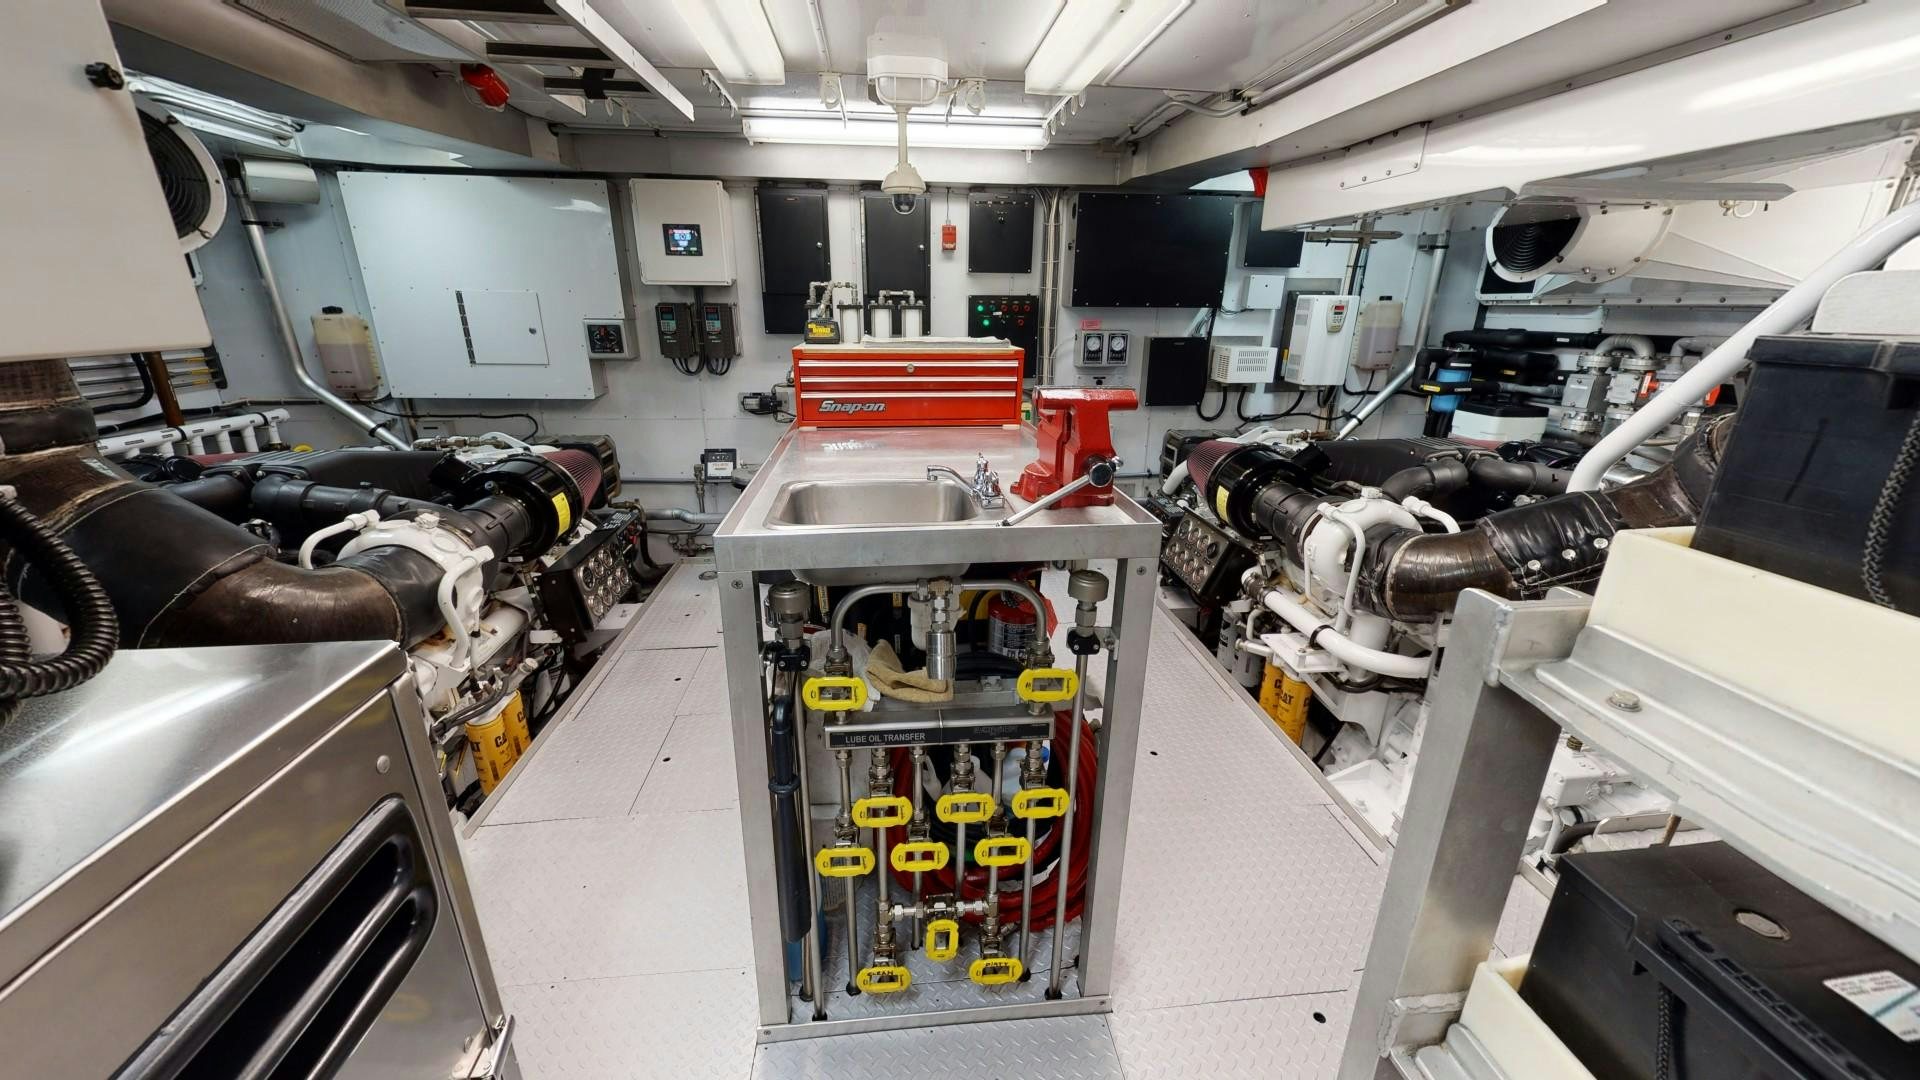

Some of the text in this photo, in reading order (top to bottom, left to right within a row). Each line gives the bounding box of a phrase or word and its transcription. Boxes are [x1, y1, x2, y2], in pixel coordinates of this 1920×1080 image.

[818, 399, 885, 414] Snap-on
[494, 731, 508, 748] CA
[845, 732, 926, 744] LUBE OIL TRANSFER
[866, 969, 894, 977] CLEAN
